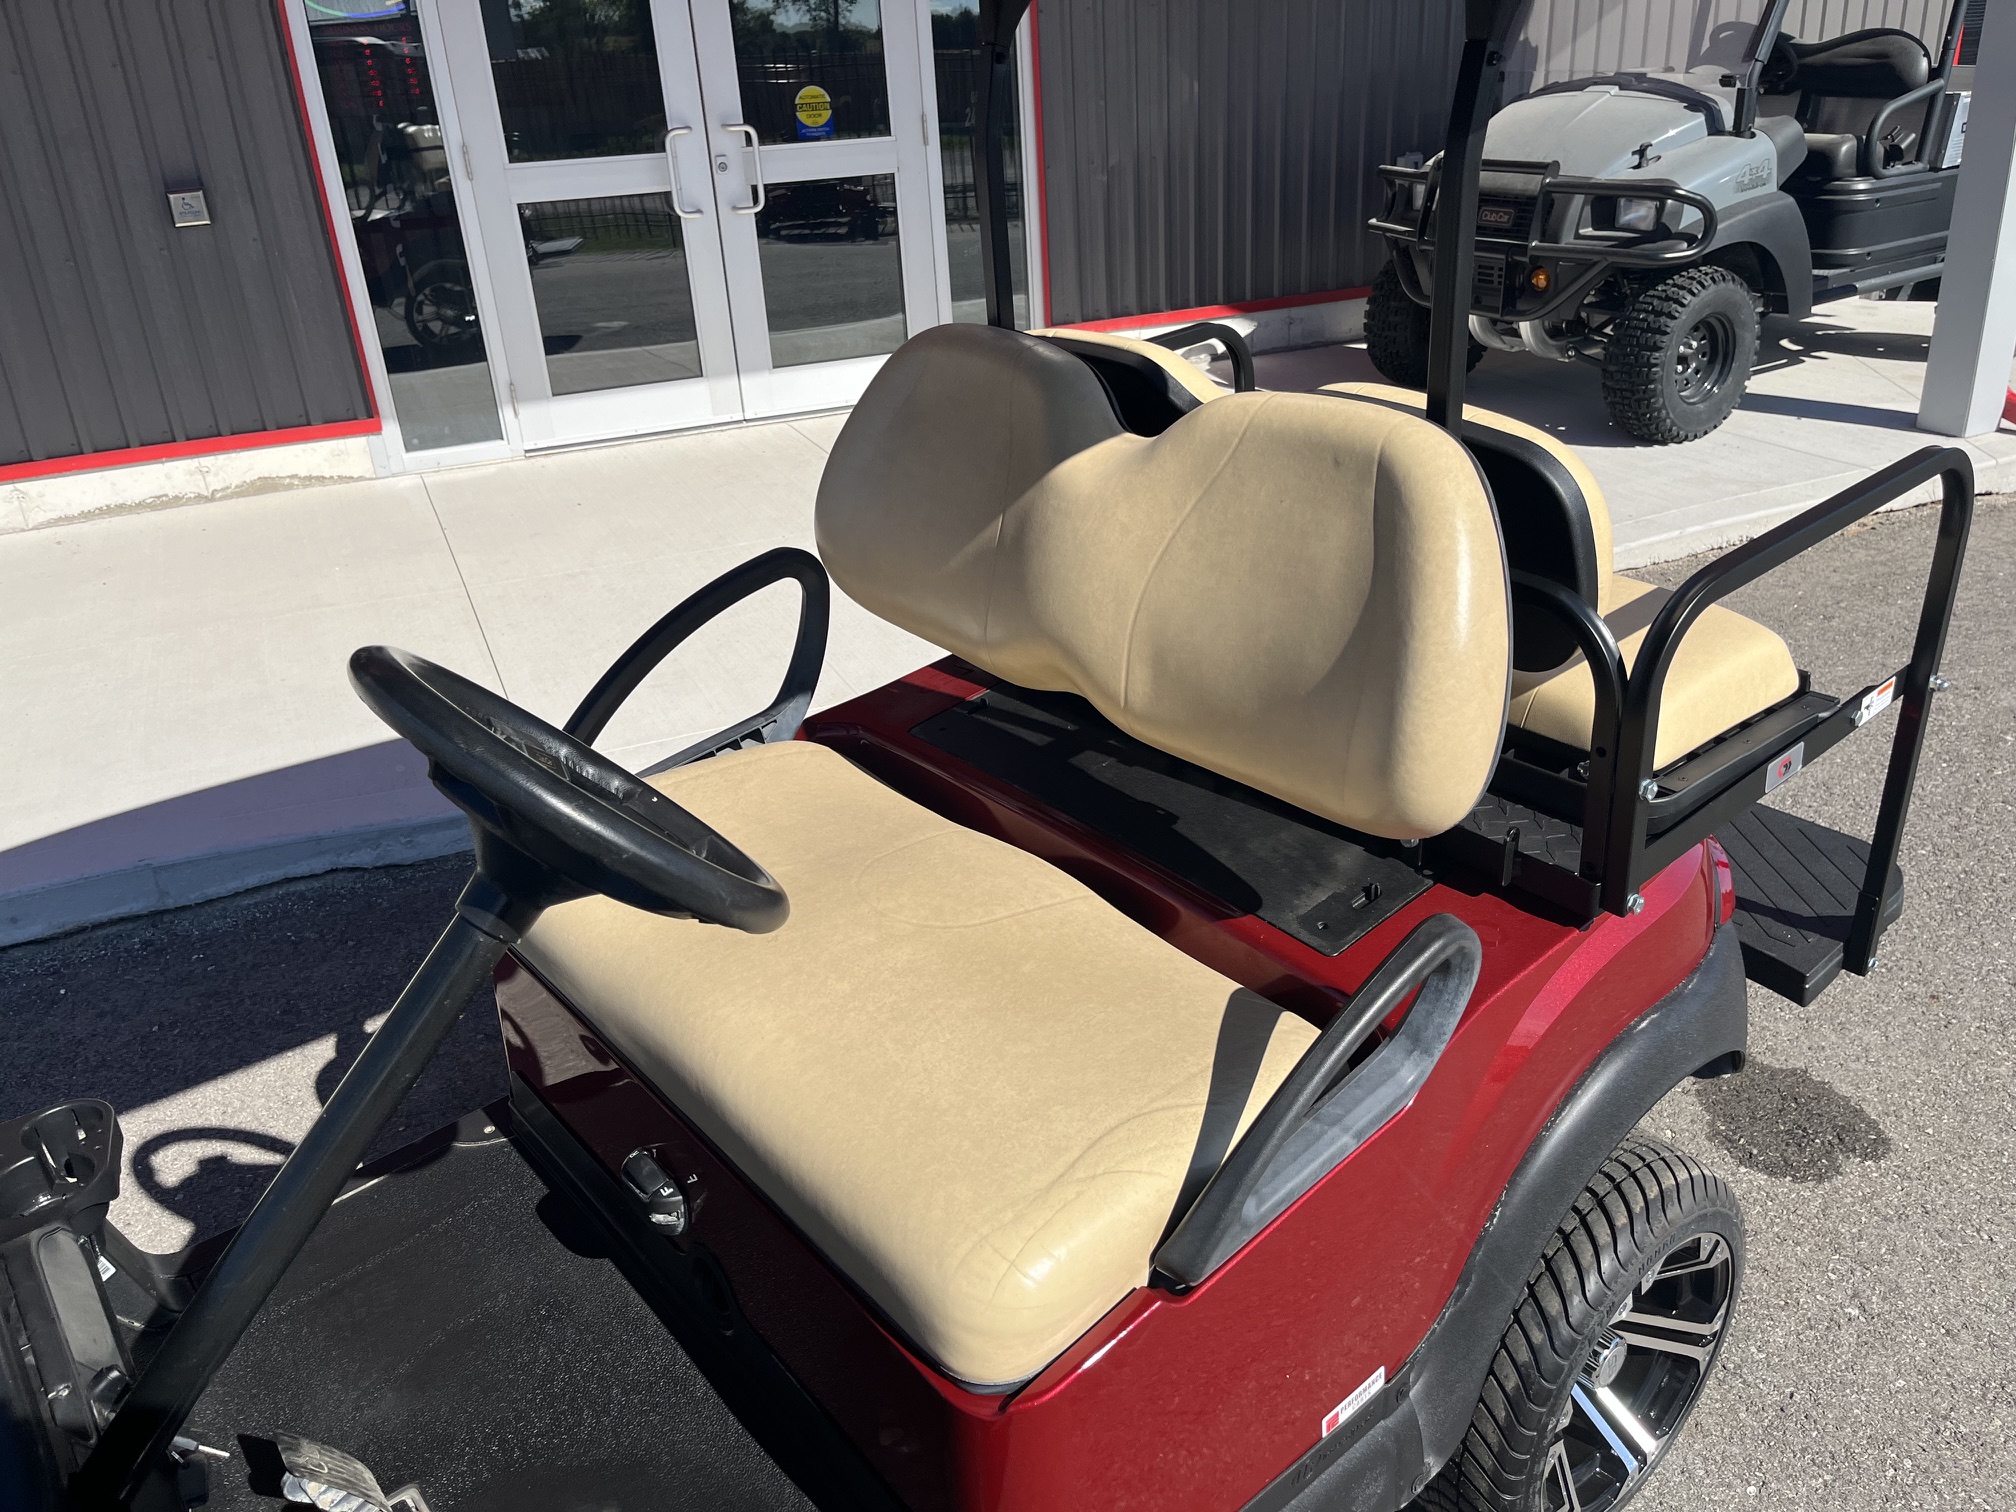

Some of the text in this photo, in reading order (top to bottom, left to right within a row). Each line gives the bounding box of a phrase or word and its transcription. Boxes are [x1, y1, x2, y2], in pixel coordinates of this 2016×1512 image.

[797, 102, 830, 112] CAUTION
[1340, 1371, 1383, 1415] PERFORMANCE
[1351, 1390, 1372, 1411] CARTS
